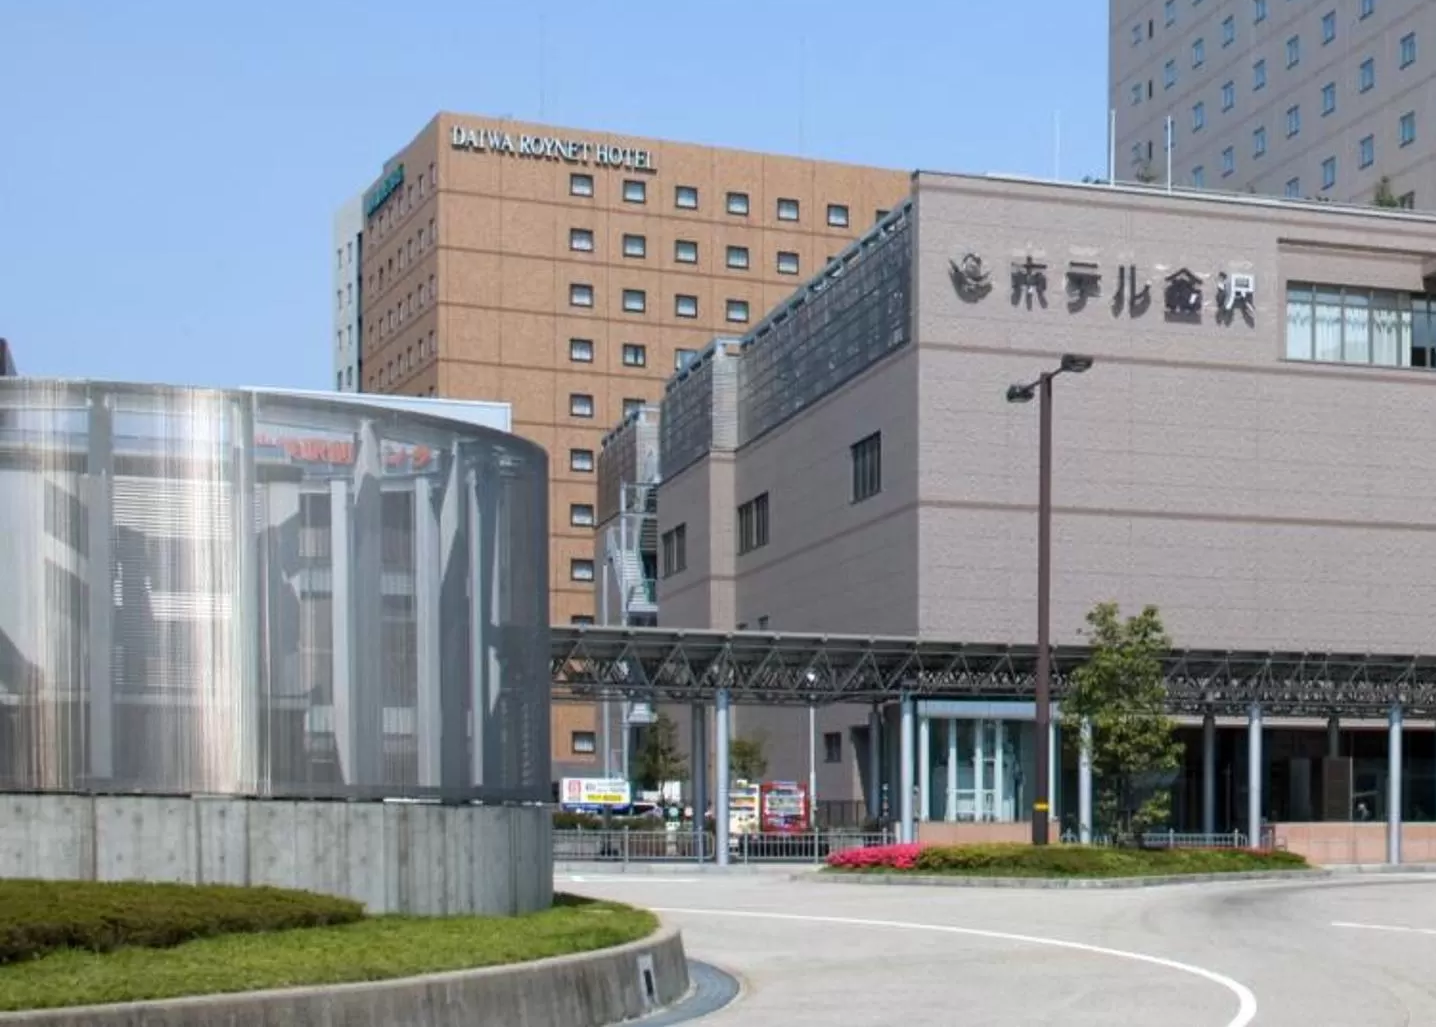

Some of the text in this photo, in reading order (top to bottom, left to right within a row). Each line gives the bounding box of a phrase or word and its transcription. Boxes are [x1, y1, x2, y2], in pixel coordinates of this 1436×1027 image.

[452, 124, 653, 169] DAIWA ROYNET HOTEL
[1010, 255, 1256, 327] ホテル金沢
